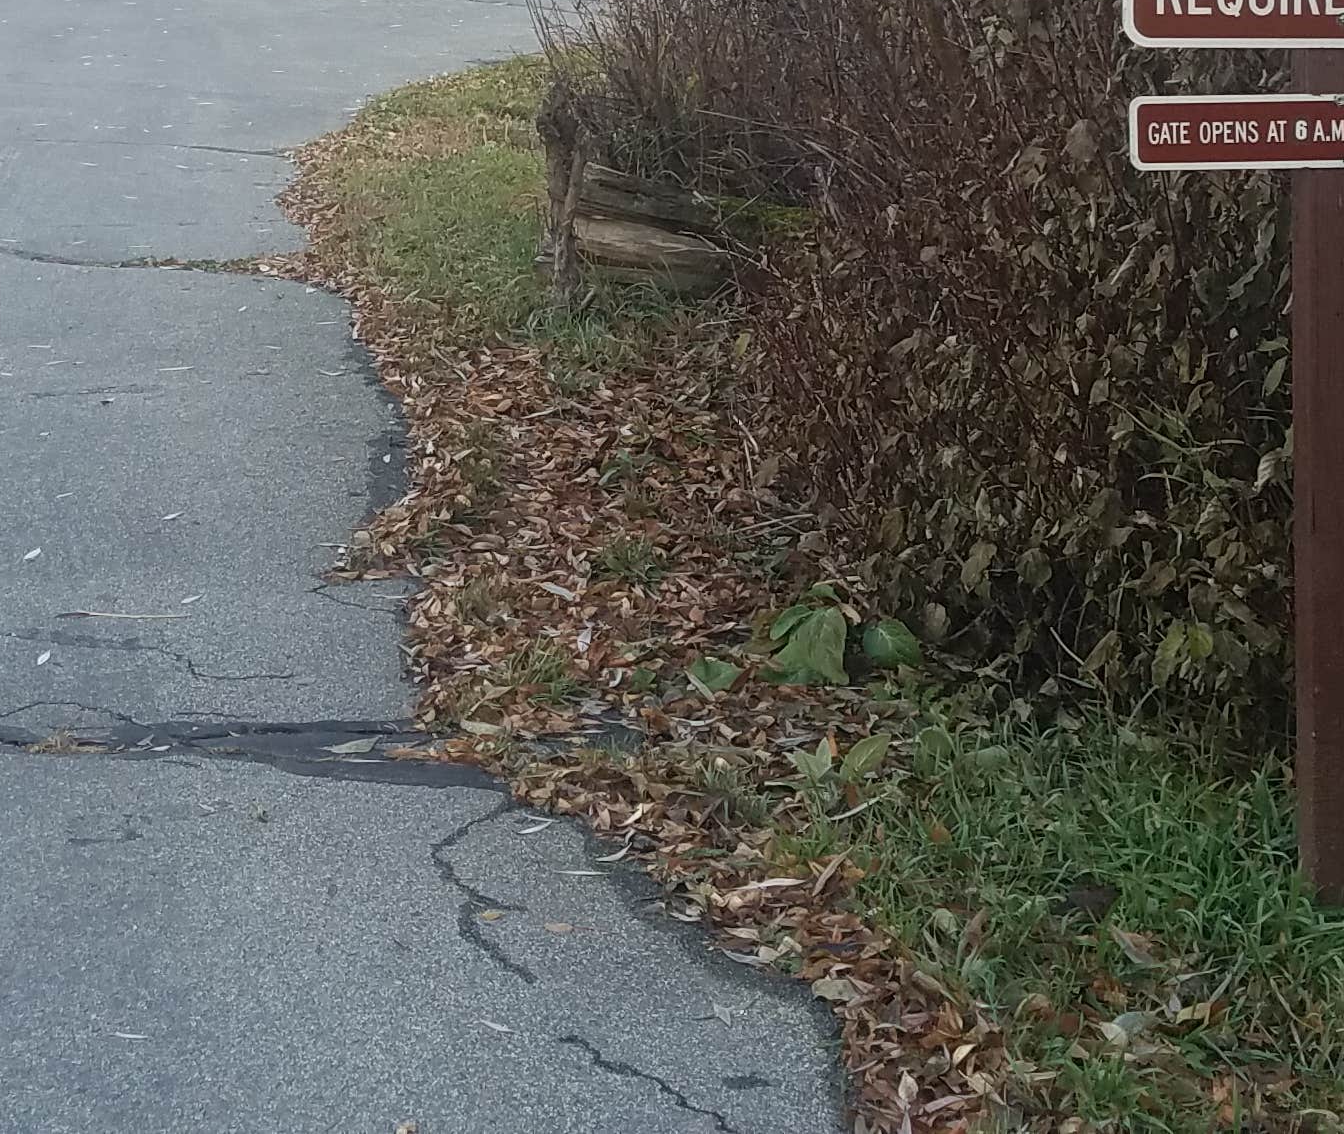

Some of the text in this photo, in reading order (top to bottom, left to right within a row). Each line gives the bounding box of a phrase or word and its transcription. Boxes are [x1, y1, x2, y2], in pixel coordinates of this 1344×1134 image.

[1148, 120, 1191, 145] GATE
[1199, 119, 1259, 144] OPENS
[1267, 119, 1287, 143] AT
[1295, 119, 1308, 141] 6
